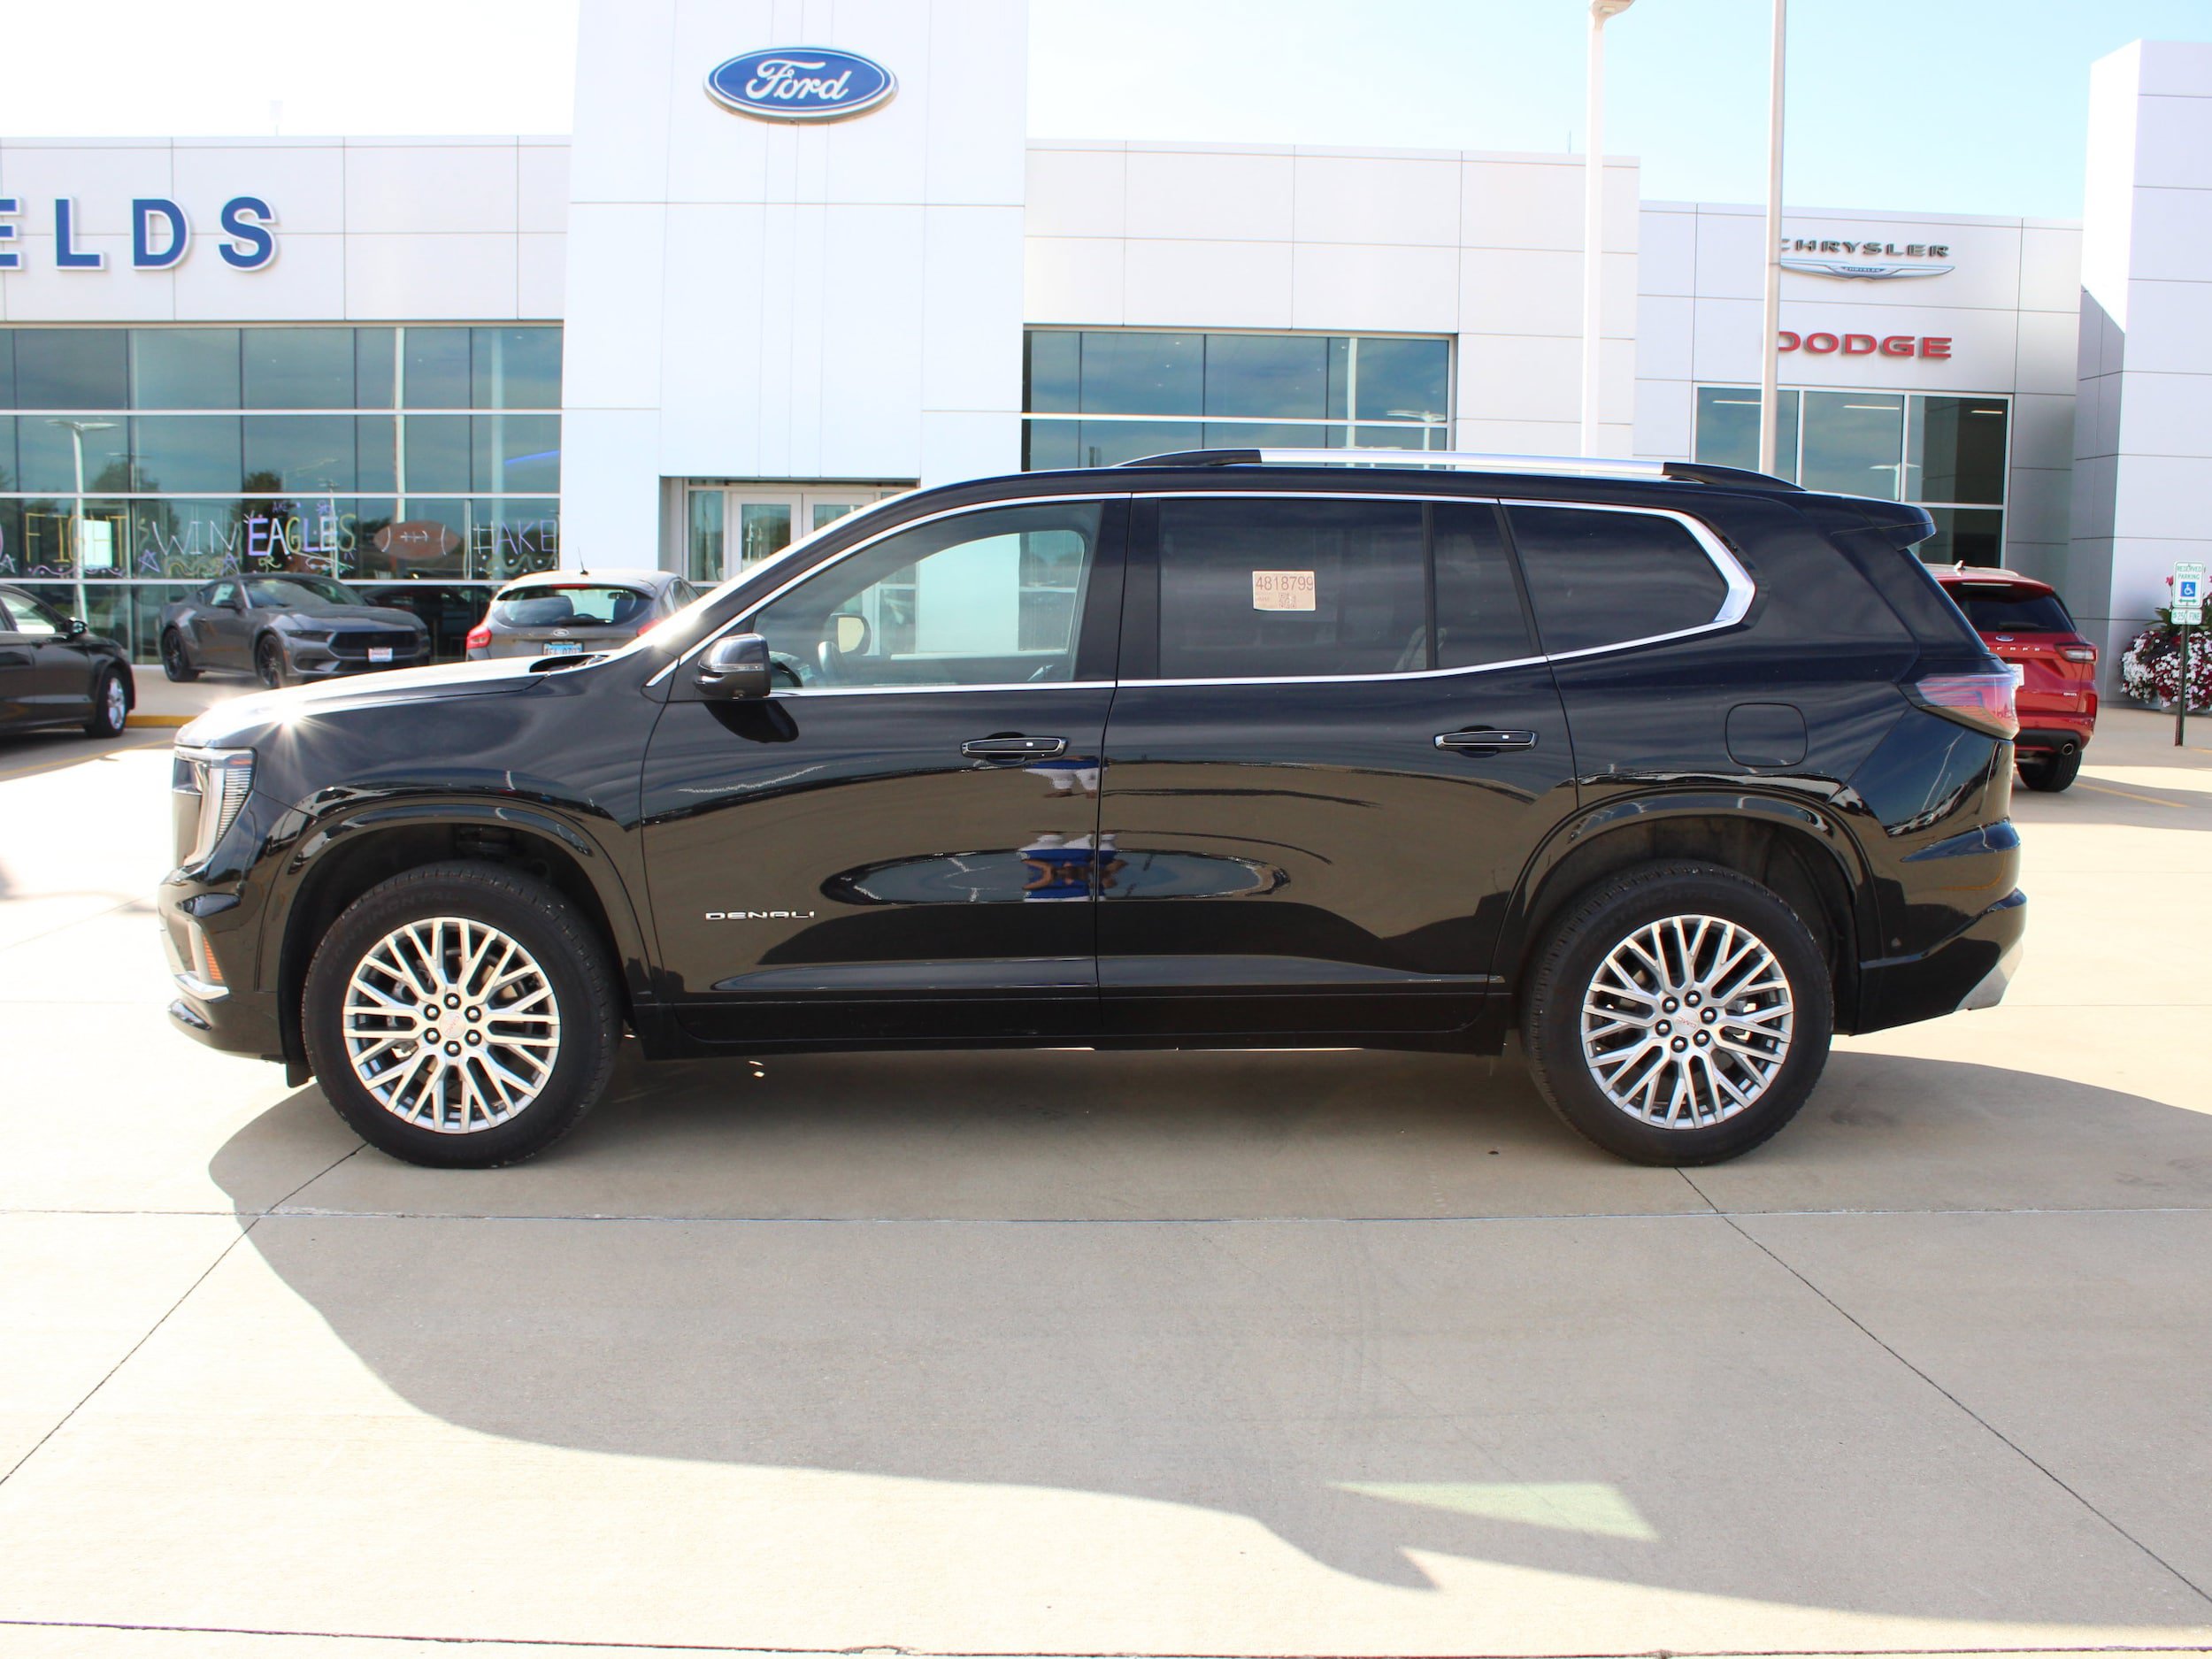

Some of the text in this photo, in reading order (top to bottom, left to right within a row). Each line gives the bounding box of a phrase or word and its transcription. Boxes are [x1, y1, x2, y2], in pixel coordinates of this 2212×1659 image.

[745, 58, 852, 100] Ford
[1778, 331, 1952, 357] DODGE
[152, 520, 241, 556] WIN
[248, 514, 357, 557] EAGLES
[1256, 576, 1314, 590] 4818799
[705, 910, 815, 920] DENALI
